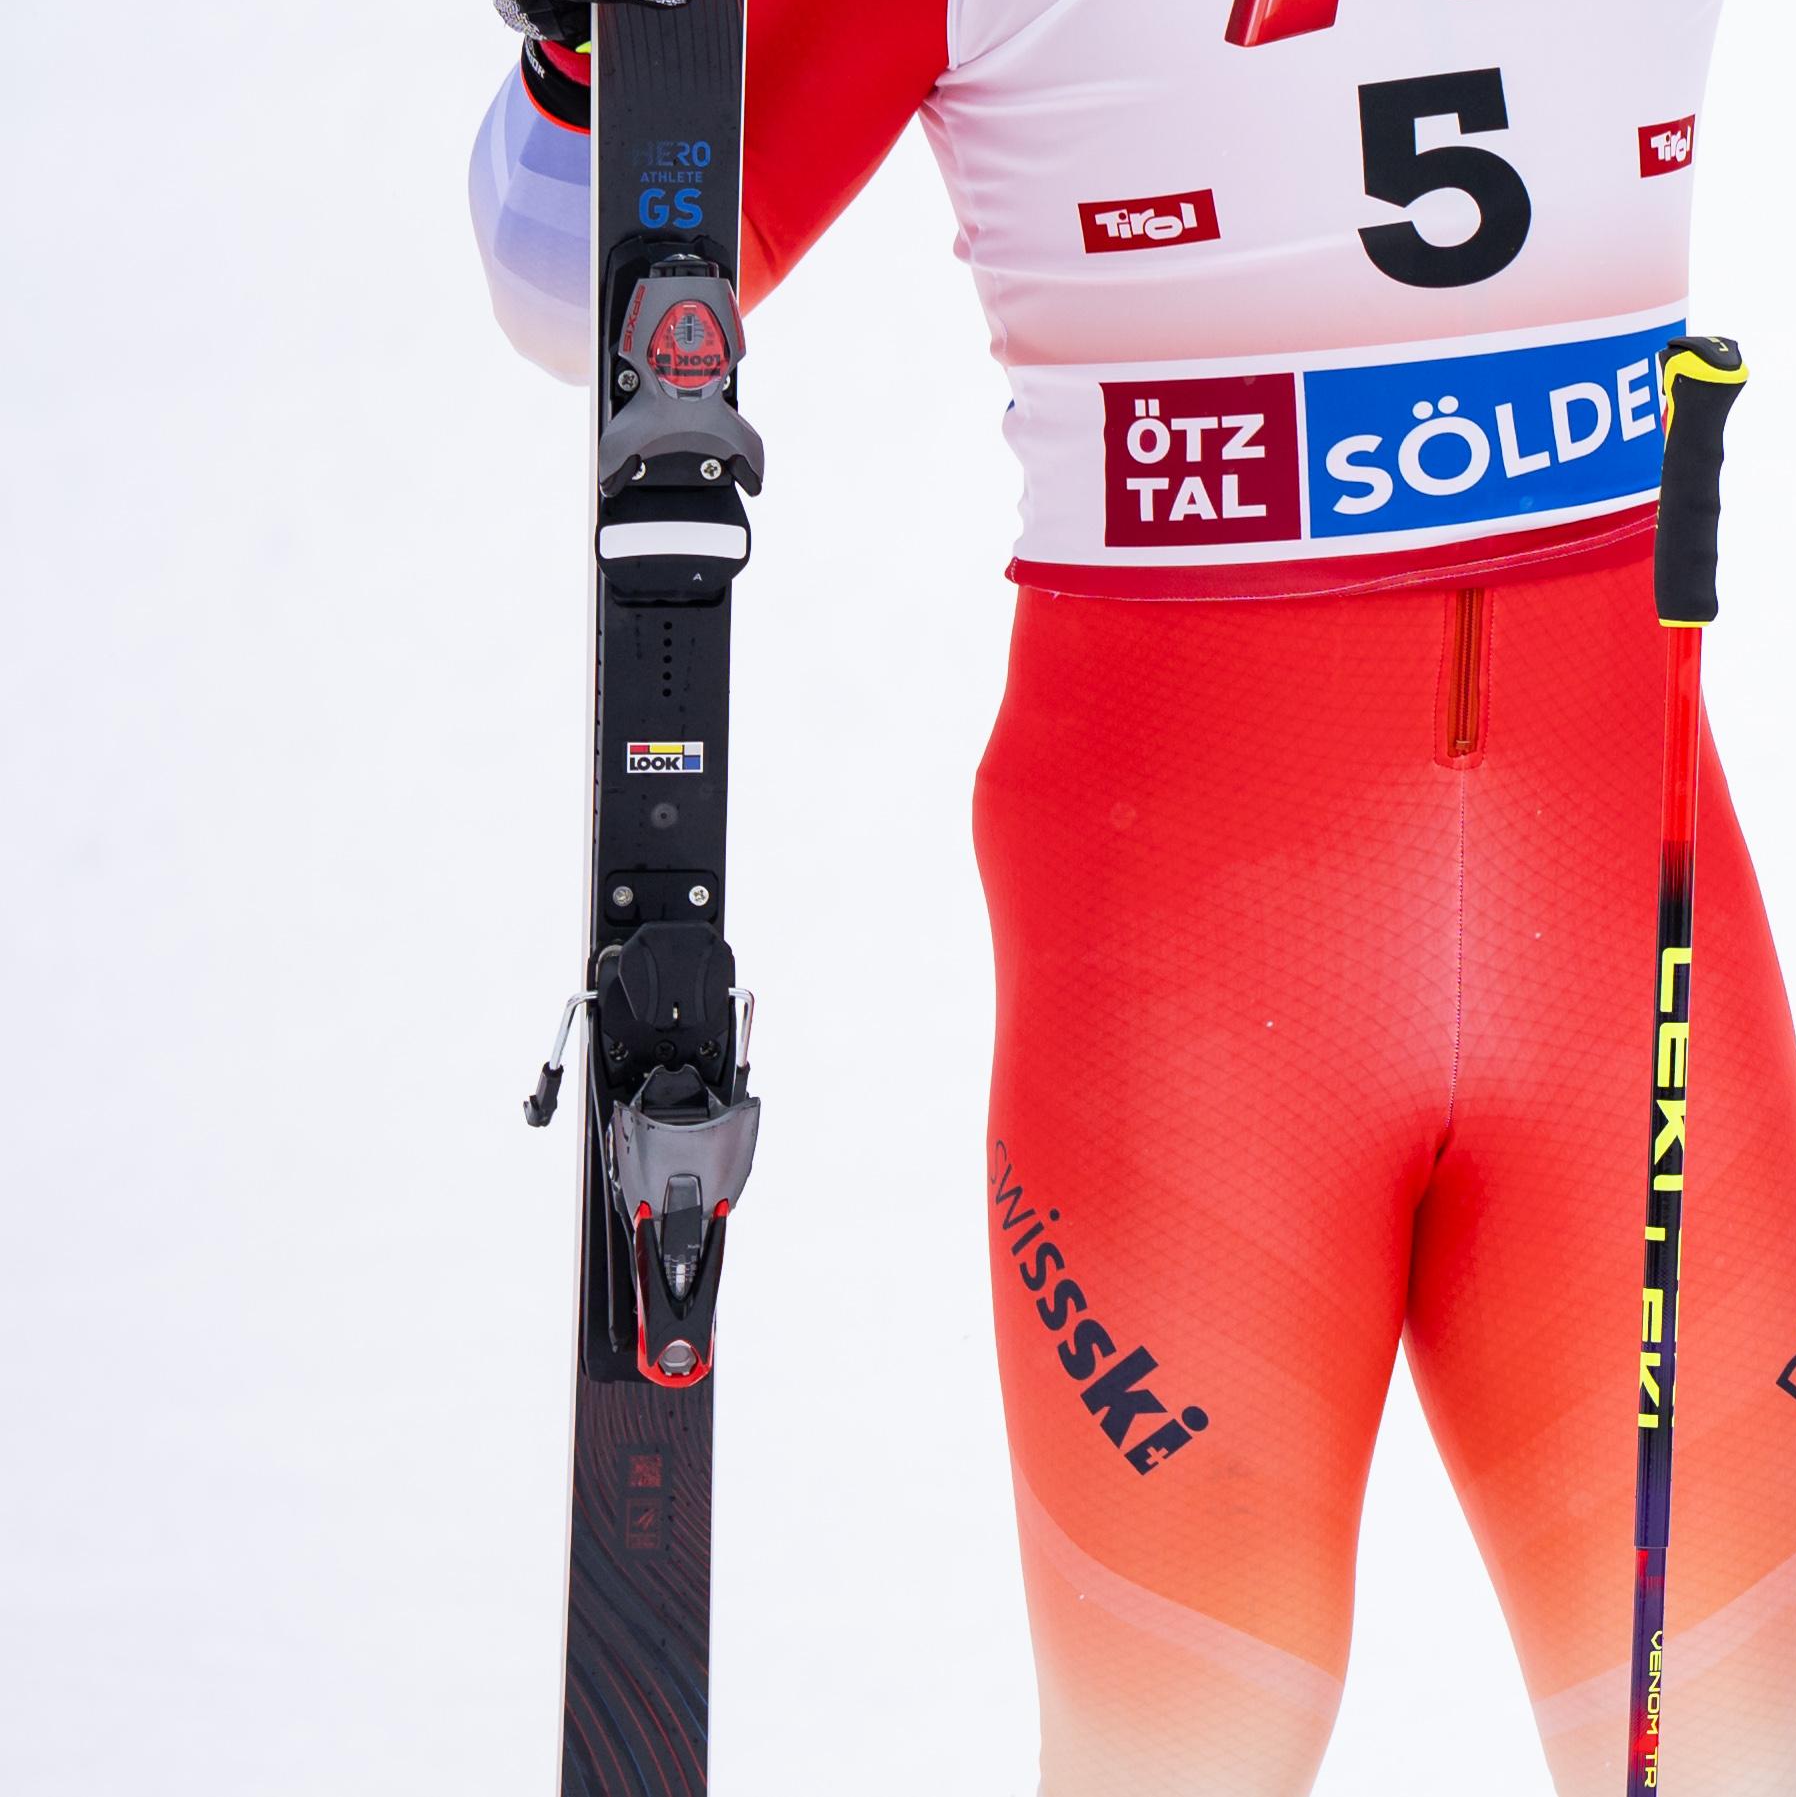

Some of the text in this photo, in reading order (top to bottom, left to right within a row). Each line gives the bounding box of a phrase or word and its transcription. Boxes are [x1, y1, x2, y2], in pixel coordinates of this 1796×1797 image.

[1651, 125, 1692, 164] Tirol
[640, 171, 703, 183] ATHLETE
[1358, 67, 1532, 289] 5
[639, 188, 703, 229] GS
[1094, 201, 1199, 241] Tirol
[1126, 399, 1266, 464] ÖTZ
[1326, 358, 1662, 516] SÖLDE
[1126, 475, 1267, 524] TAL
[629, 754, 682, 771] LOOK
[1654, 946, 1692, 1190] LEKI
[990, 1139, 1209, 1476] swissski
[1644, 1629, 1663, 1789] VENOM TR
